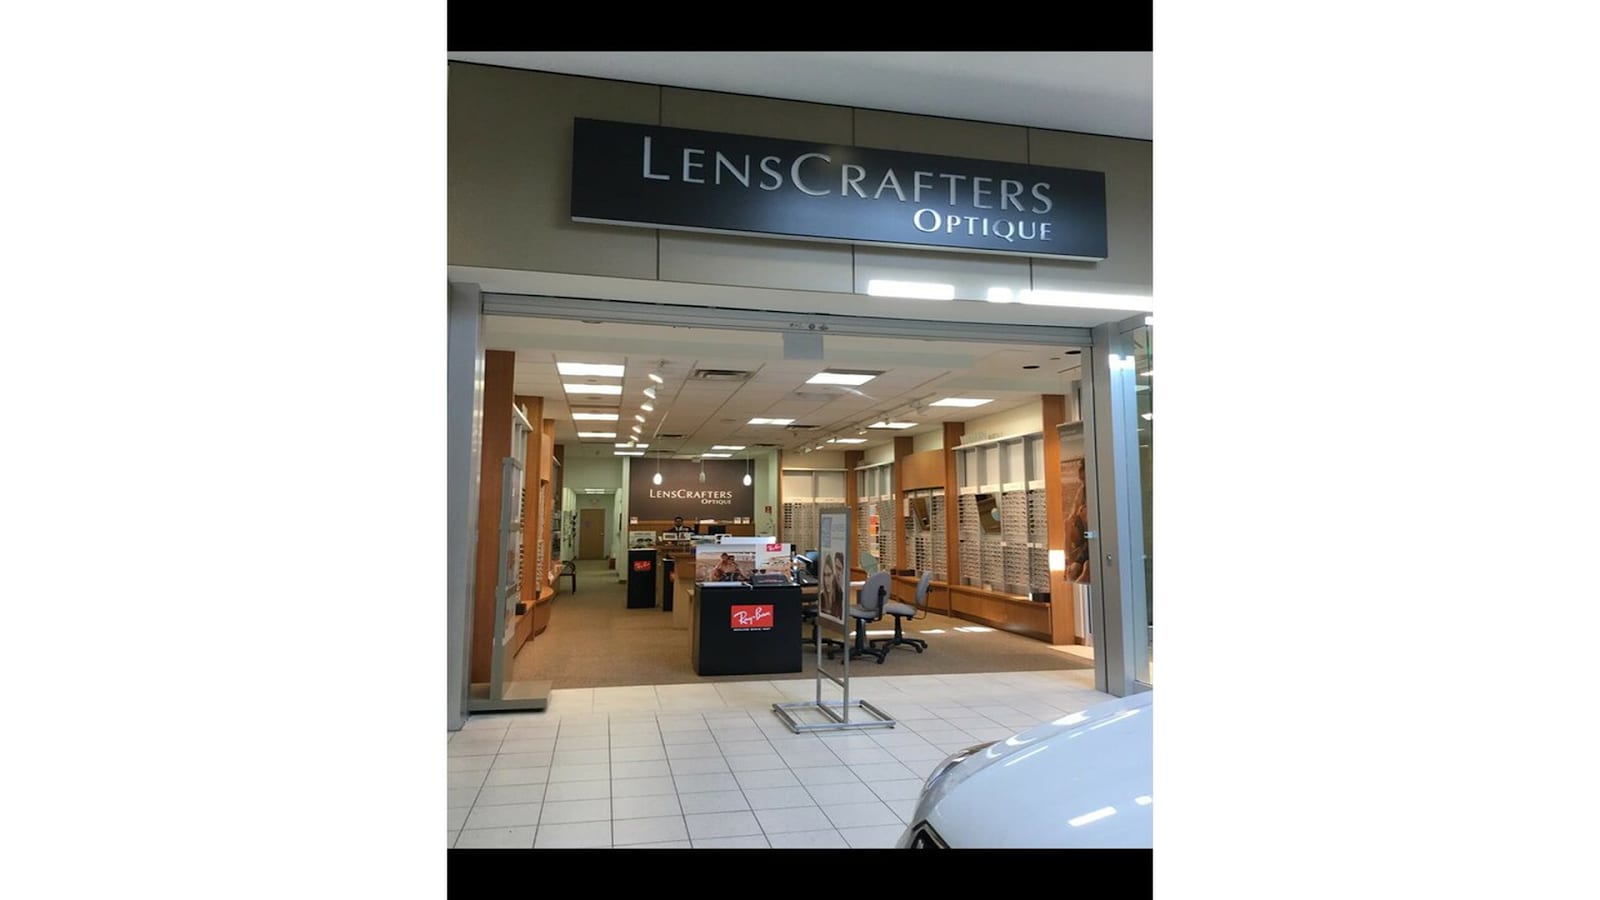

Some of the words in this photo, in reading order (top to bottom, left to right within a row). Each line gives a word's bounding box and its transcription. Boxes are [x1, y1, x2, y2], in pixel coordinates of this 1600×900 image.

[642, 136, 1053, 214] LENSCRAFTERS
[912, 208, 1053, 242] OPTIQUE
[649, 488, 733, 499] LENSCRAFTERS
[700, 498, 732, 506] OPTIQUE
